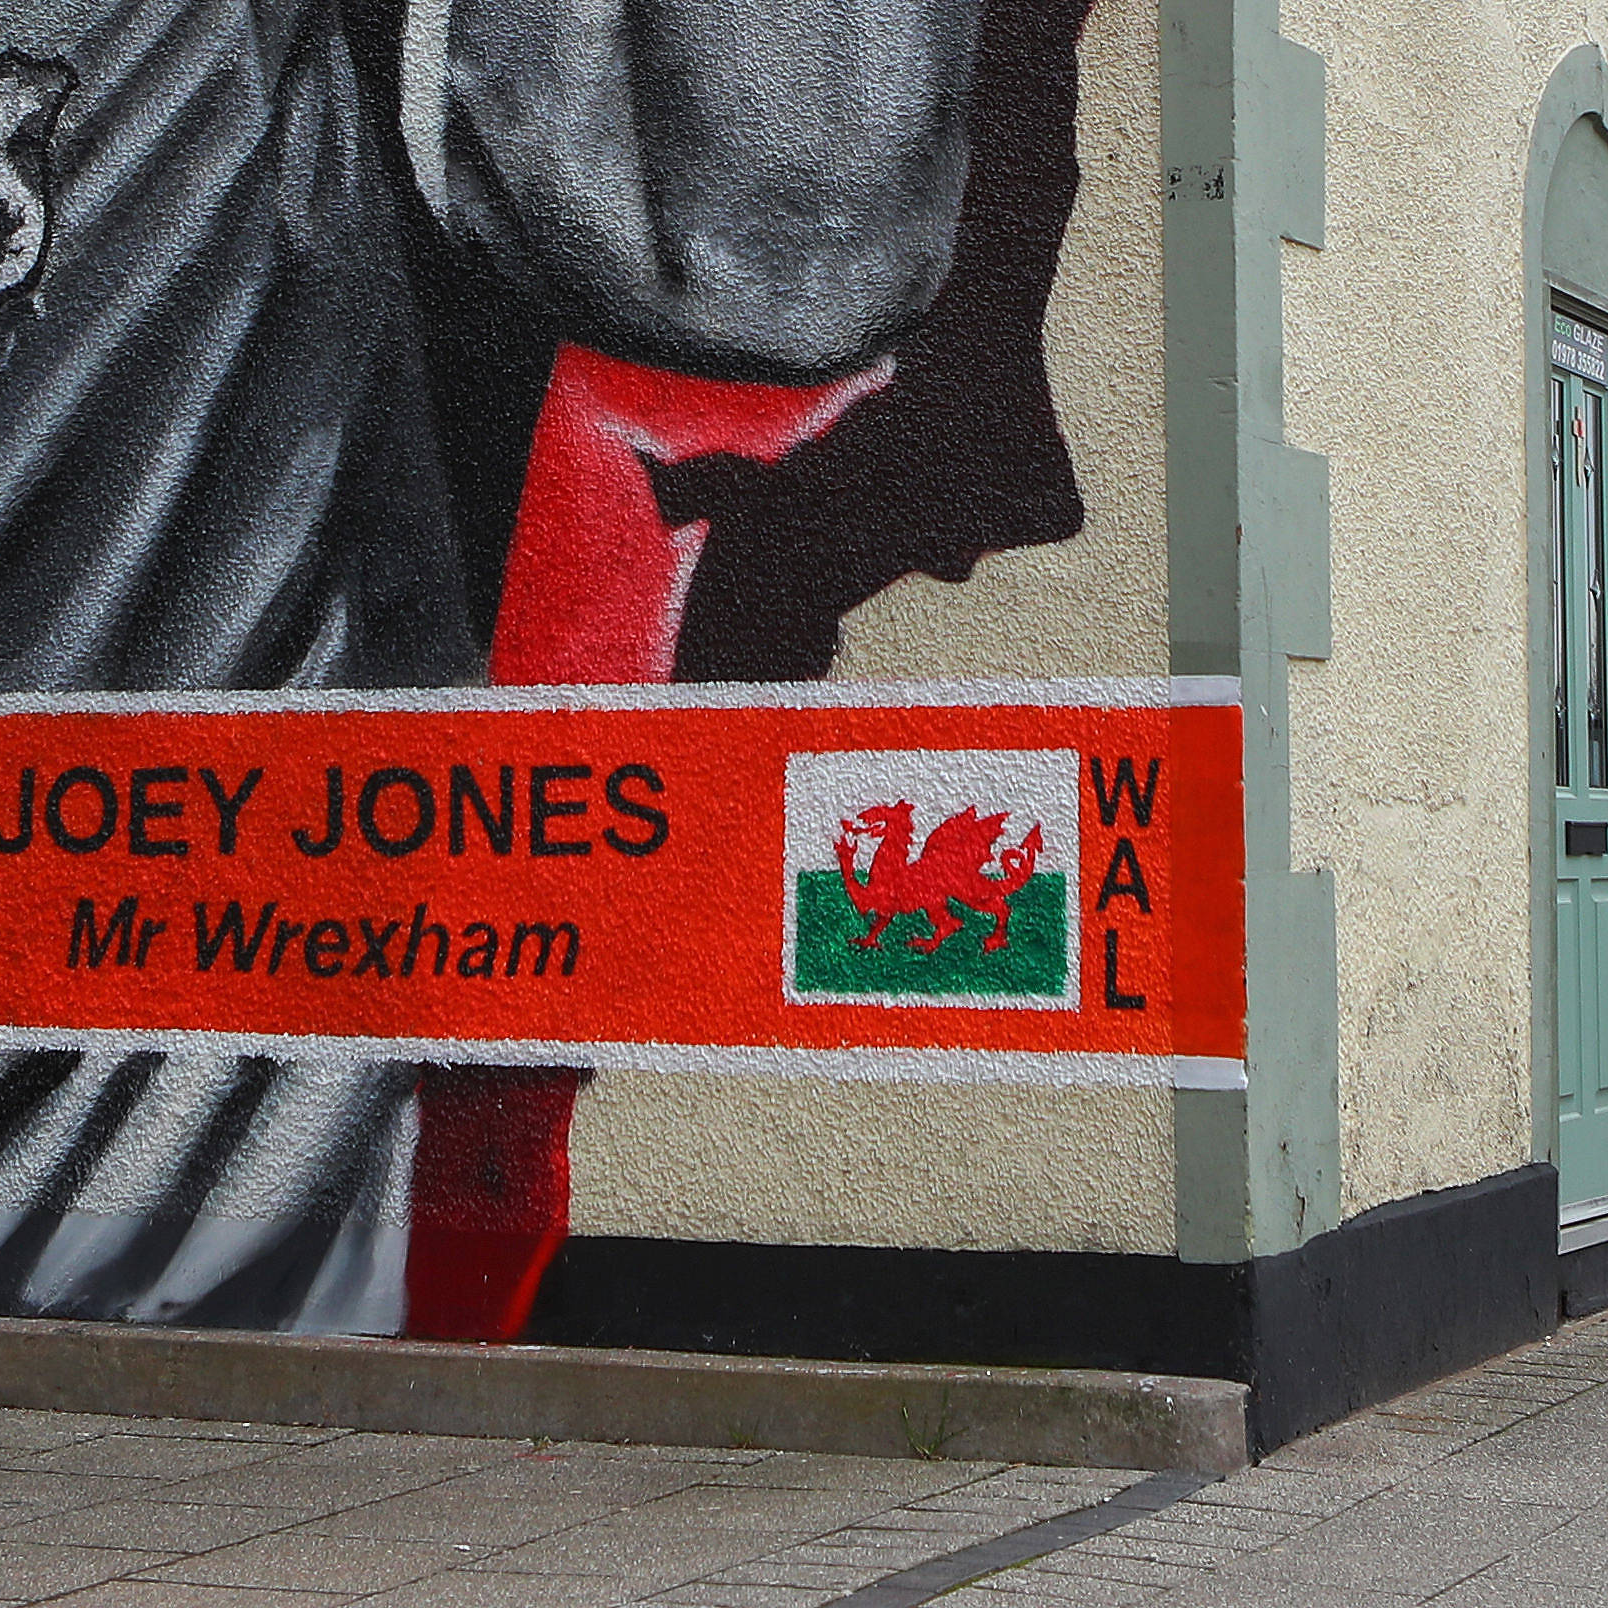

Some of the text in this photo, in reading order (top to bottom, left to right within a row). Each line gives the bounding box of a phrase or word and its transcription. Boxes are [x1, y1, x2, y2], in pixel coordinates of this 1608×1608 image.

[1574, 324, 1604, 353] GLAZE
[293, 764, 670, 858] JONES
[67, 896, 581, 979] Mr Wrexham
